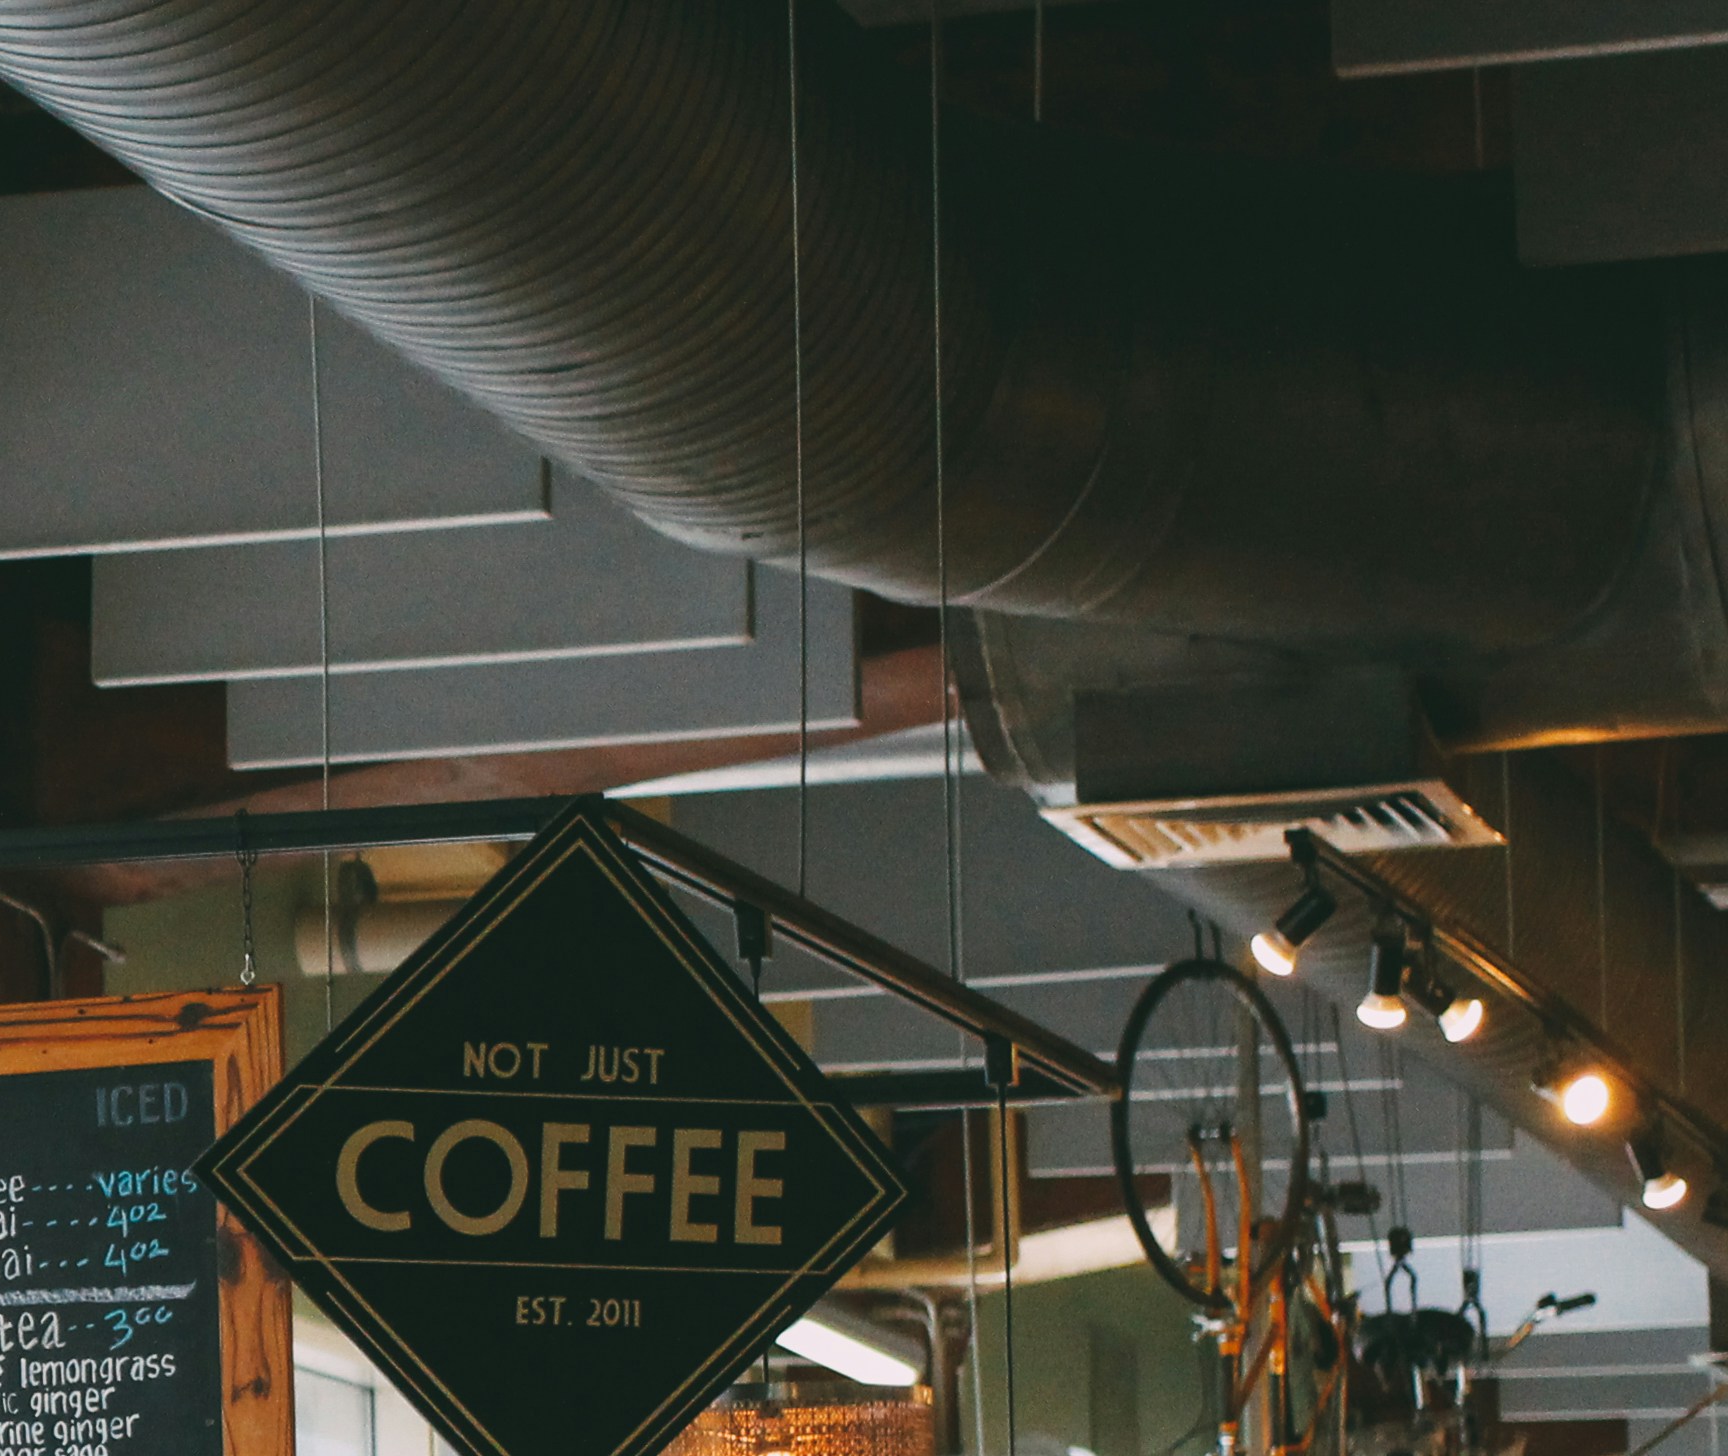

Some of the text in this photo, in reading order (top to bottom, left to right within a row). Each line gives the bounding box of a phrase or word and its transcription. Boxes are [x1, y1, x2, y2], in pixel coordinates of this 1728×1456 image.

[463, 1041, 665, 1084] NOT JUST
[96, 1082, 189, 1128] ICED
[96, 1165, 197, 1198] varies
[335, 1118, 786, 1246] COFFEE
[106, 1202, 166, 1238] 402
[104, 1239, 169, 1277] 402
[515, 1296, 642, 1329] EST. 2011
[20, 1353, 176, 1389] lemongrass
[30, 1386, 116, 1418] ginger
[53, 1412, 140, 1446] ginger
